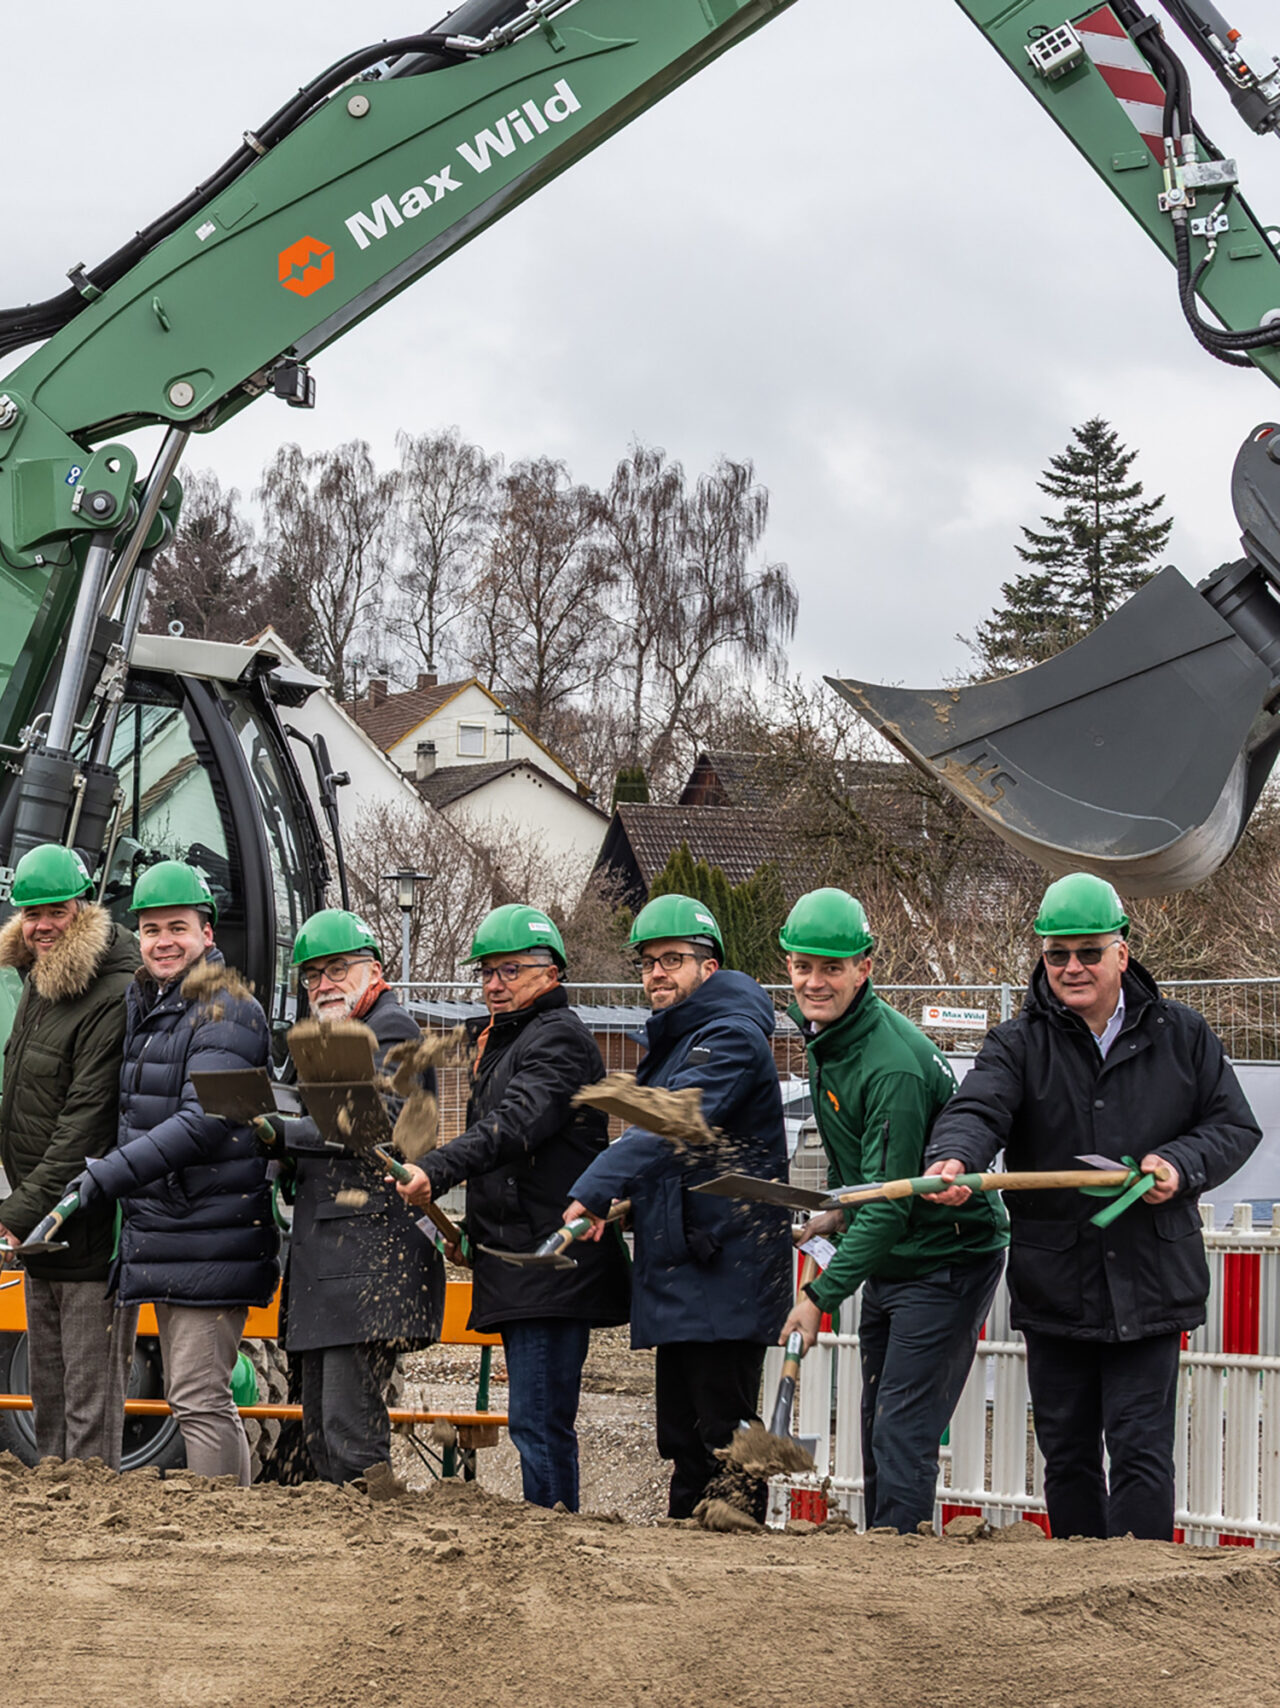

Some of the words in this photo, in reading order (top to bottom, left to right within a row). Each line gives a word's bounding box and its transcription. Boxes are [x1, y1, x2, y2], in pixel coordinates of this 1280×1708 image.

[344, 164, 463, 250] Max
[456, 78, 582, 174] Wild
[942, 1011, 961, 1019] Max
[964, 1012, 985, 1020] Wild
